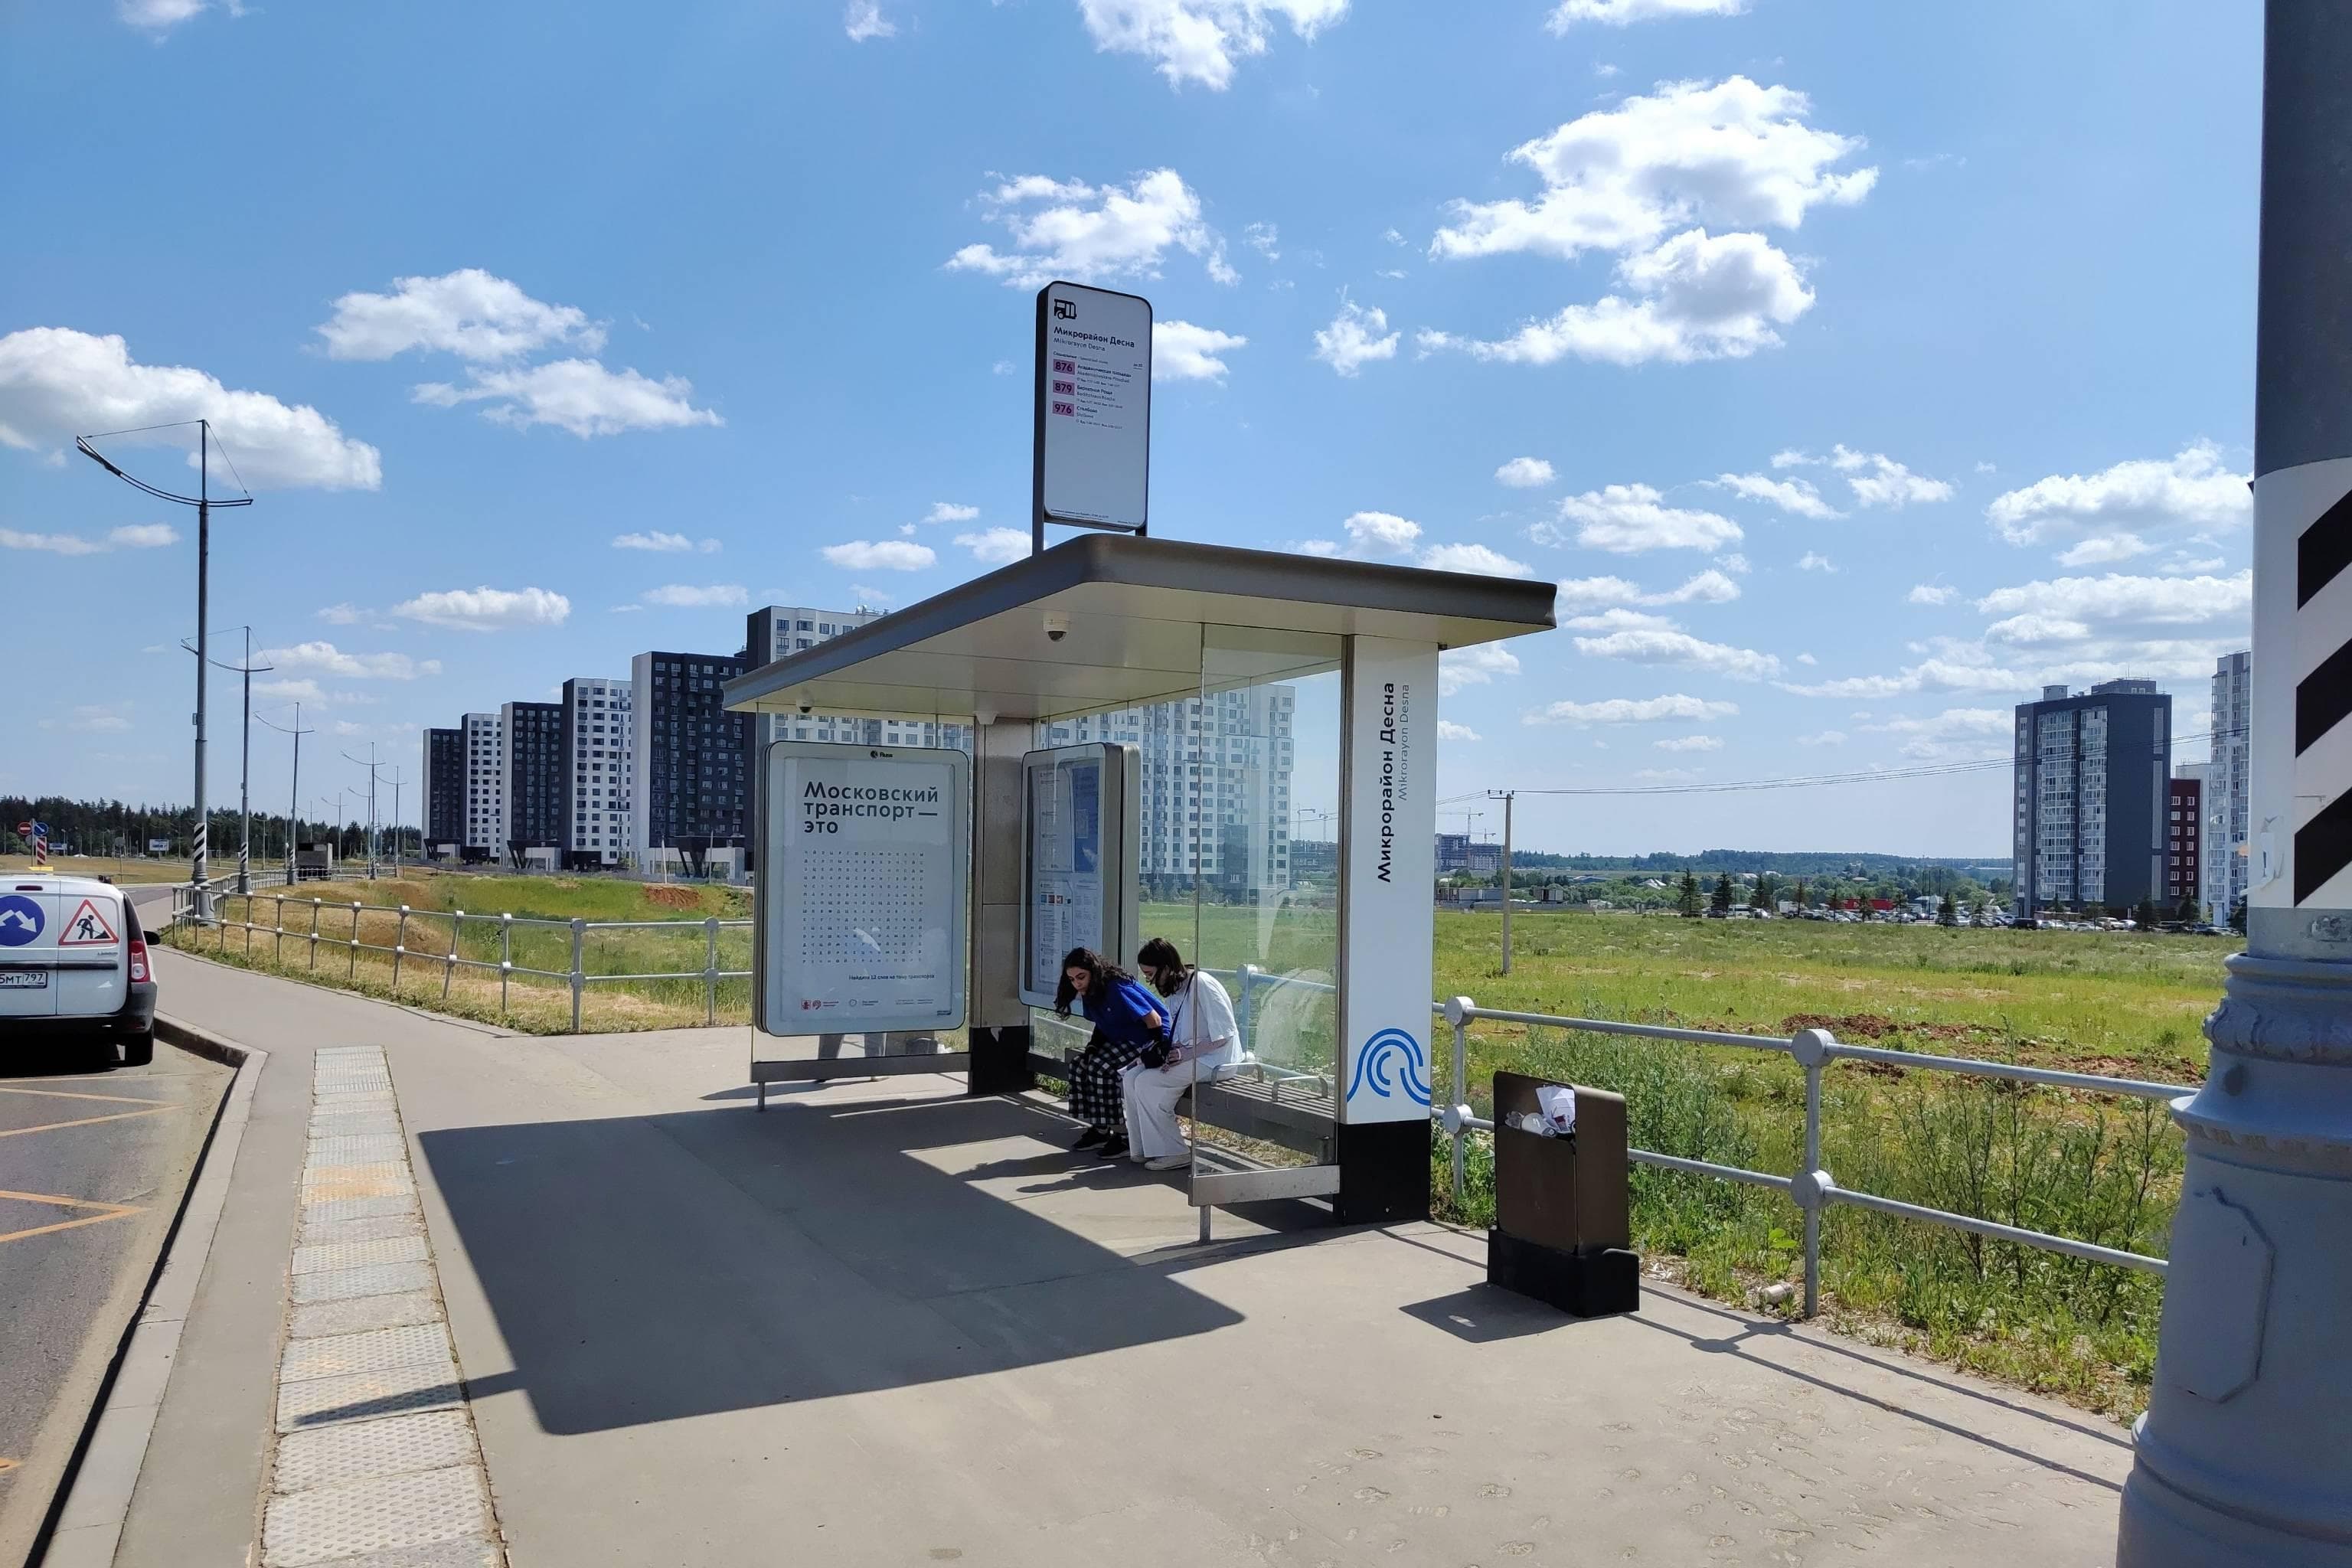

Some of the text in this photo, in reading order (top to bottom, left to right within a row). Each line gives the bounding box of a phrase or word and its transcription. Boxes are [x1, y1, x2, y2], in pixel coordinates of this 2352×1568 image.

[1054, 326, 1135, 348] Микрорайон Десна
[1088, 343, 1106, 351] Desna
[1055, 361, 1073, 372] 876
[1054, 382, 1072, 393] 879
[1054, 403, 1072, 413] 976
[1398, 684, 1410, 801] Mikrorayon Desna
[1377, 682, 1396, 883] Микрорайон Десна
[805, 781, 939, 802] Московский
[804, 802, 915, 822] транспорт
[804, 821, 838, 834] это
[24, 973, 44, 982] 797
